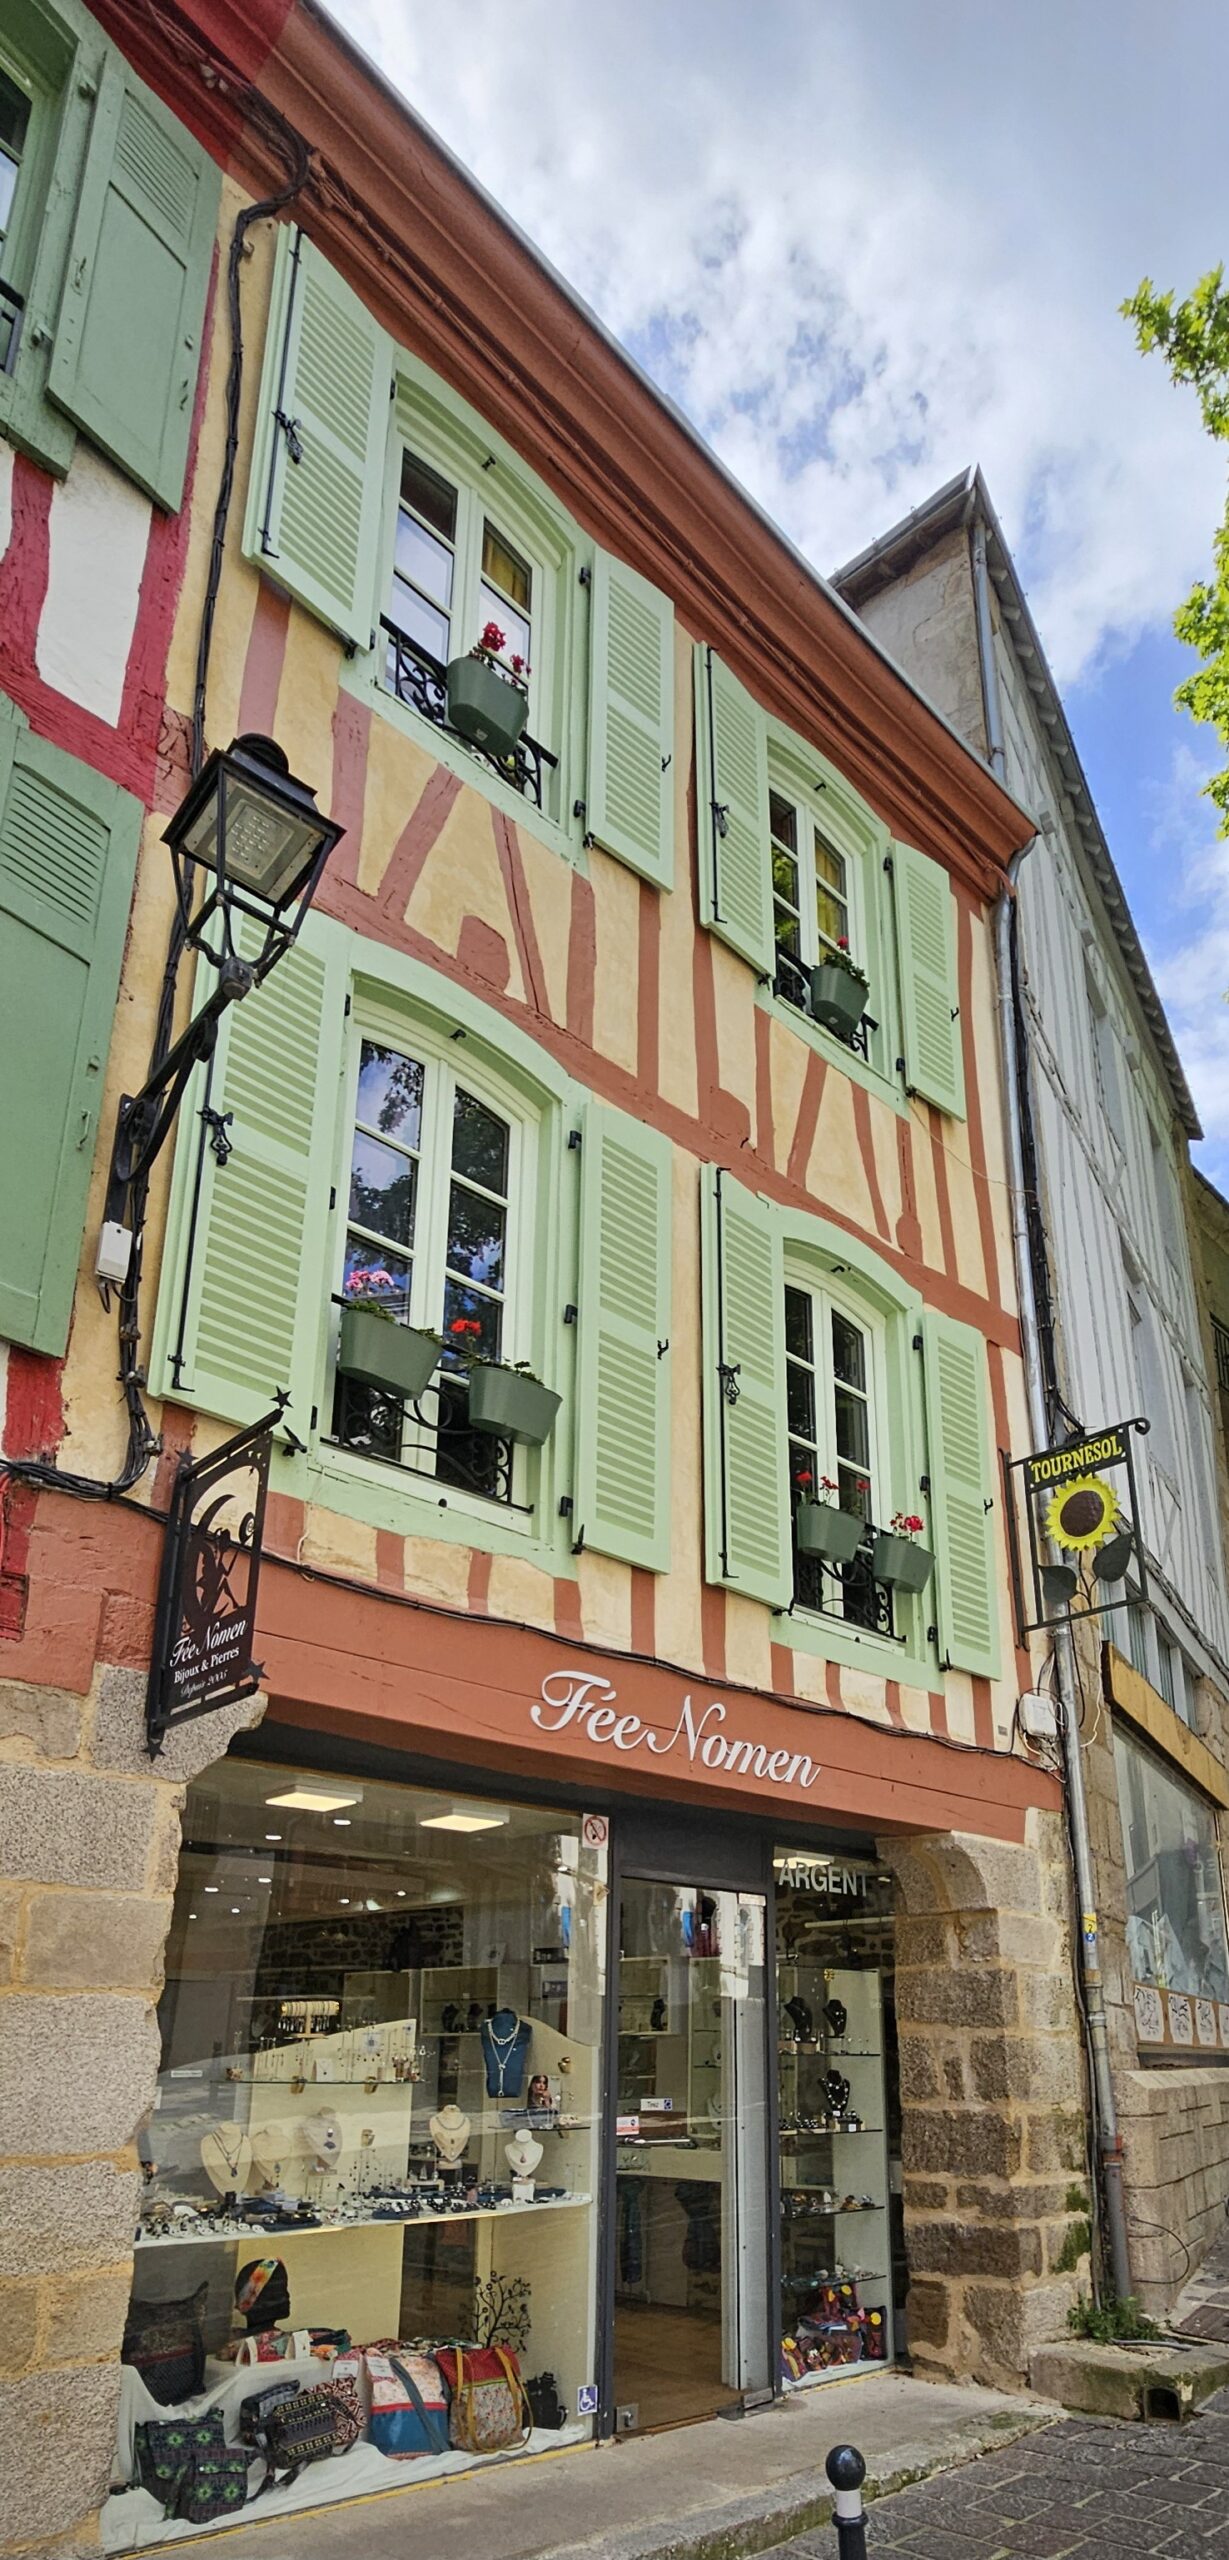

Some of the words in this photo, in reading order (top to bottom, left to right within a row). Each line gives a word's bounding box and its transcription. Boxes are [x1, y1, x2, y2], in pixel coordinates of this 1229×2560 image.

[1031, 1435, 1122, 1483] TOURNESOL
[169, 1636, 196, 1667] Fée
[195, 1620, 247, 1655] Nomen
[173, 1665, 200, 1684] Bijoux
[200, 1659, 210, 1672] &
[210, 1647, 240, 1668] Pierres
[530, 1670, 650, 1750] Fée
[646, 1695, 821, 1787] Nomen
[779, 1858, 870, 1897] ARGENT
